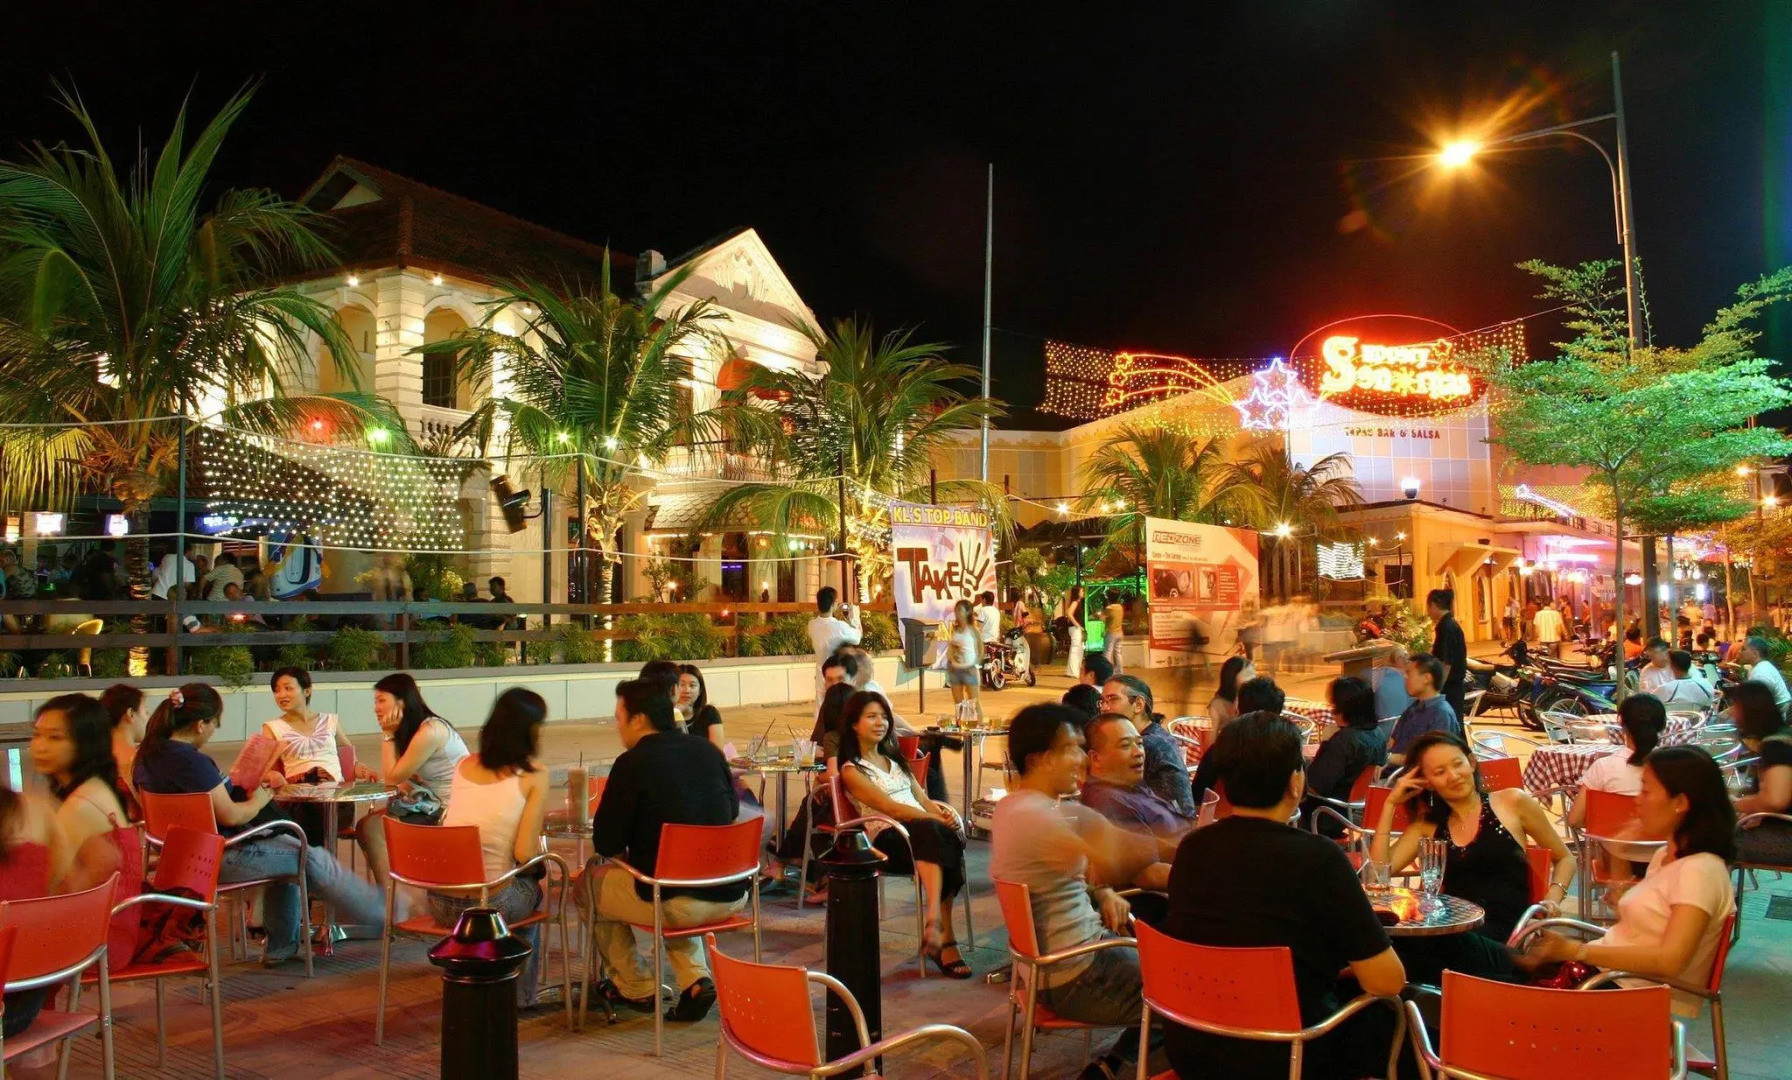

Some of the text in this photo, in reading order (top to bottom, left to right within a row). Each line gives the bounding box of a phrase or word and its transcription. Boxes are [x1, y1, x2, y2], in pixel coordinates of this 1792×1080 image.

[1377, 428, 1395, 438] BAR
[1400, 429, 1407, 438] &
[1411, 429, 1440, 439] SALSA
[893, 506, 988, 528] KL'S TOP BAND
[896, 547, 960, 604] TAKE
